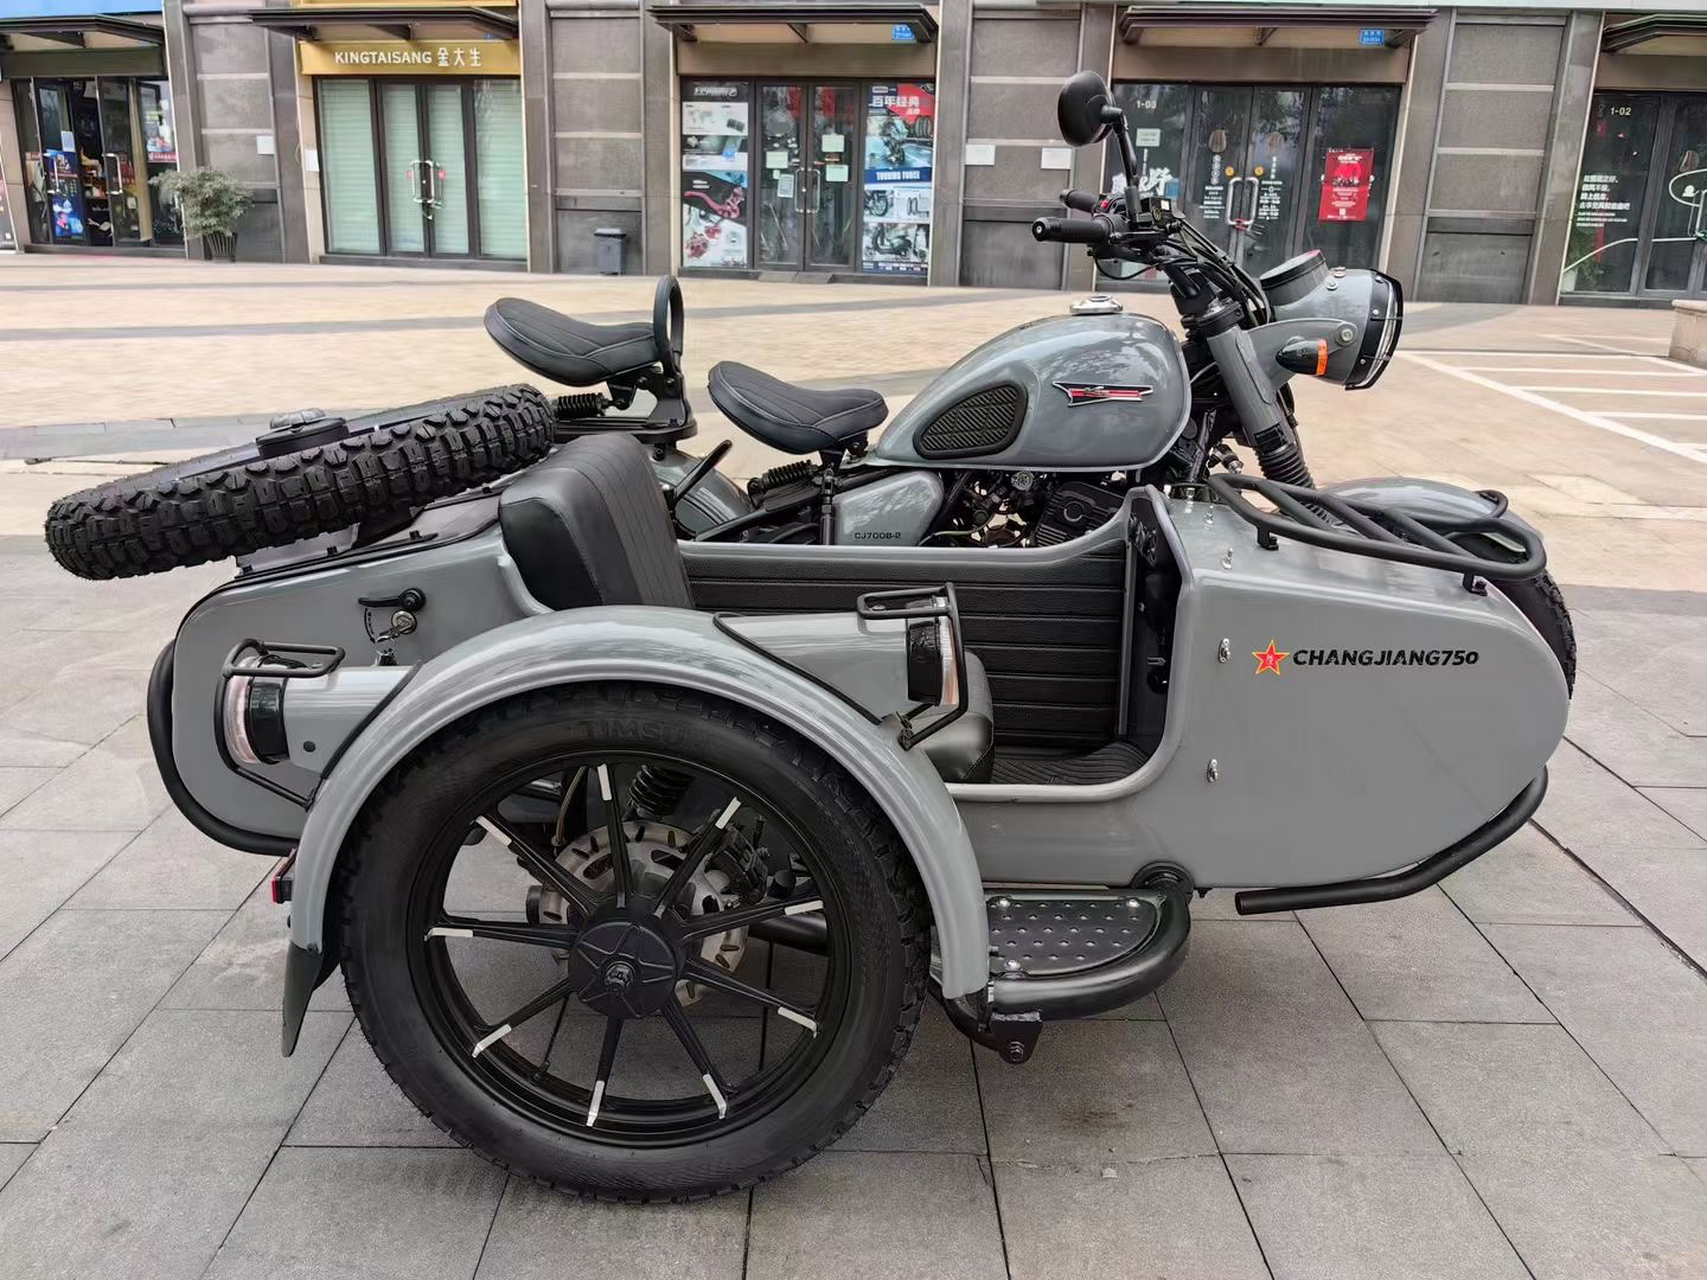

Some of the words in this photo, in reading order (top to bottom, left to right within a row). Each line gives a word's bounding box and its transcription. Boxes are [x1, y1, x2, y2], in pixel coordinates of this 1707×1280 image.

[334, 51, 432, 64] KINGTAISANG
[437, 46, 482, 67] 金大生
[1610, 106, 1632, 116] 1-02
[1292, 649, 1480, 666] CHANGJIANG750
